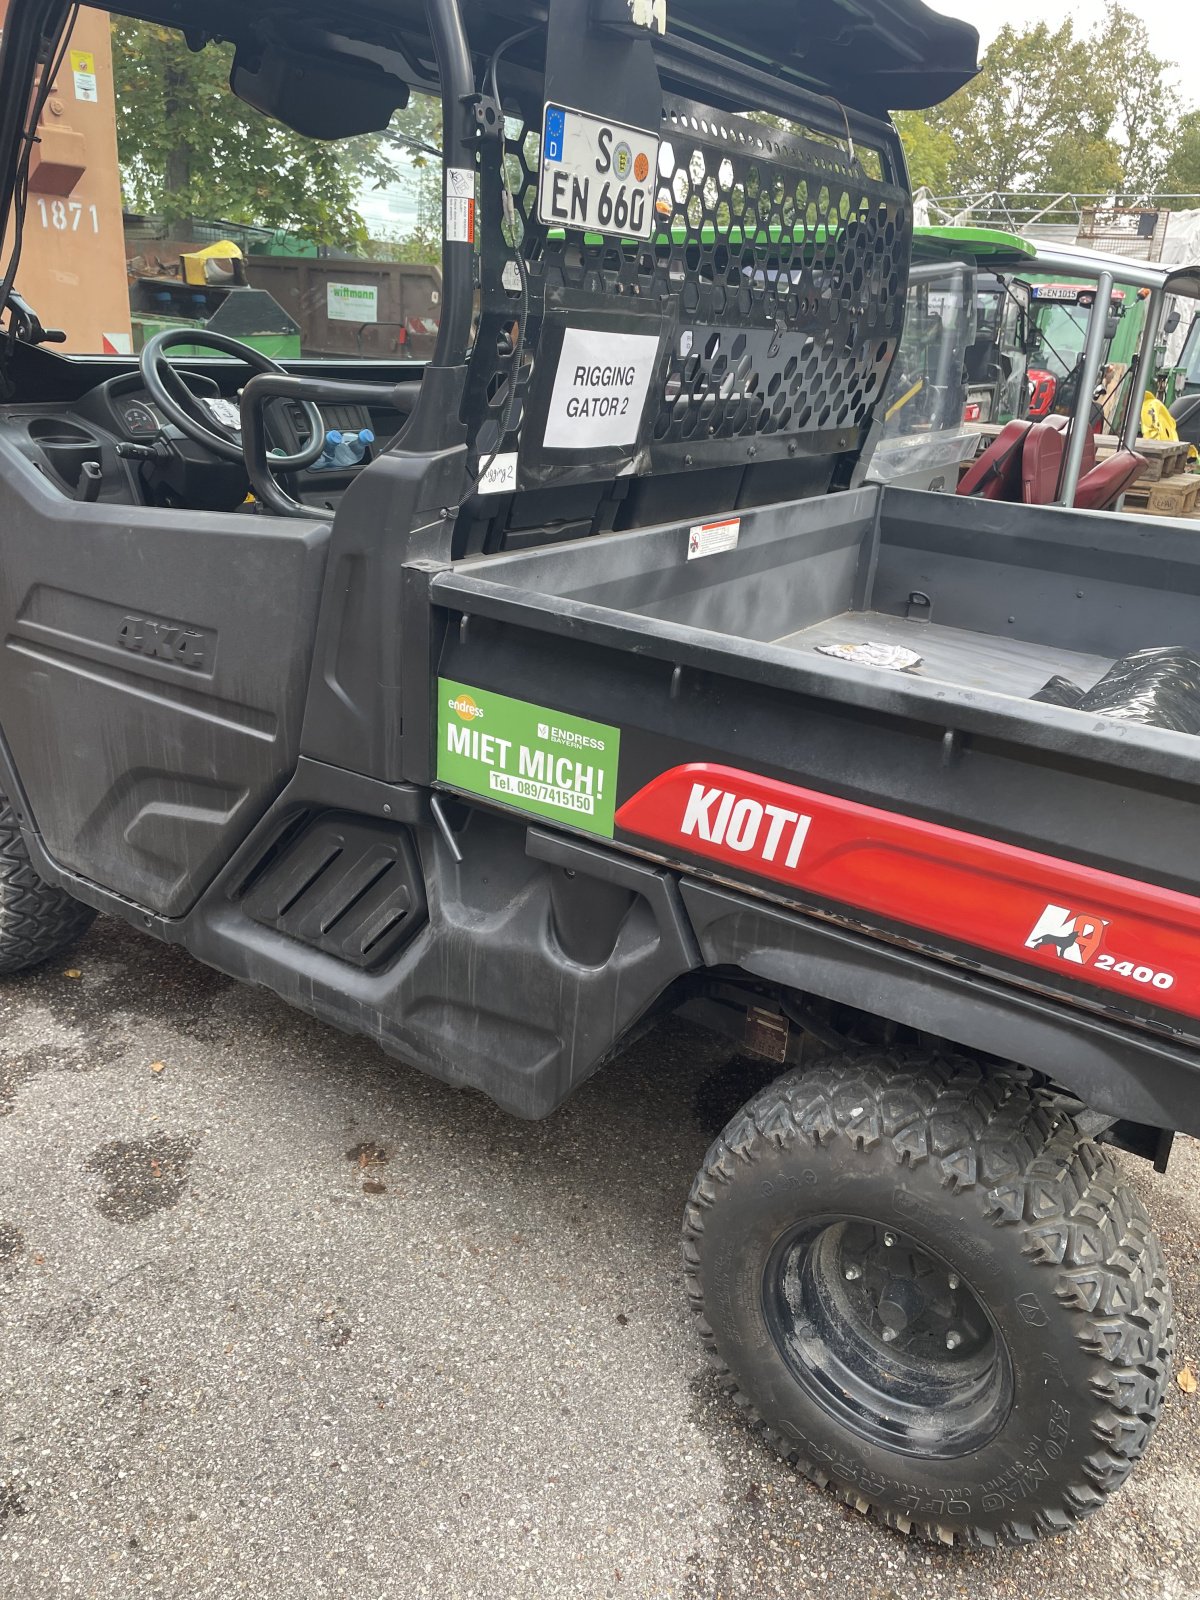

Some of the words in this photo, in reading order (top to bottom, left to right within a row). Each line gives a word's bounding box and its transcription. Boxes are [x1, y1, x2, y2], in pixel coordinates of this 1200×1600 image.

[549, 141, 557, 157] D
[596, 127, 613, 174] S
[38, 198, 99, 233] 1871
[551, 169, 589, 222] EN
[598, 181, 644, 232] 660
[1047, 289, 1058, 297] EN
[1058, 290, 1076, 298] 1015
[572, 365, 635, 387] RIGGING
[566, 396, 620, 418] GATOR
[619, 396, 629, 415] 2
[507, 465, 514, 479] 2
[117, 616, 205, 669] 4X4
[448, 698, 484, 718] endress
[551, 726, 605, 751] ENDRESS
[551, 735, 583, 750] BAYERN
[447, 722, 512, 769] MIET
[518, 744, 604, 800] MICH!
[492, 773, 514, 791] Tel.
[517, 780, 591, 811] 089/7415150
[680, 782, 813, 869] KIOTI
[1094, 954, 1174, 989] 2400
